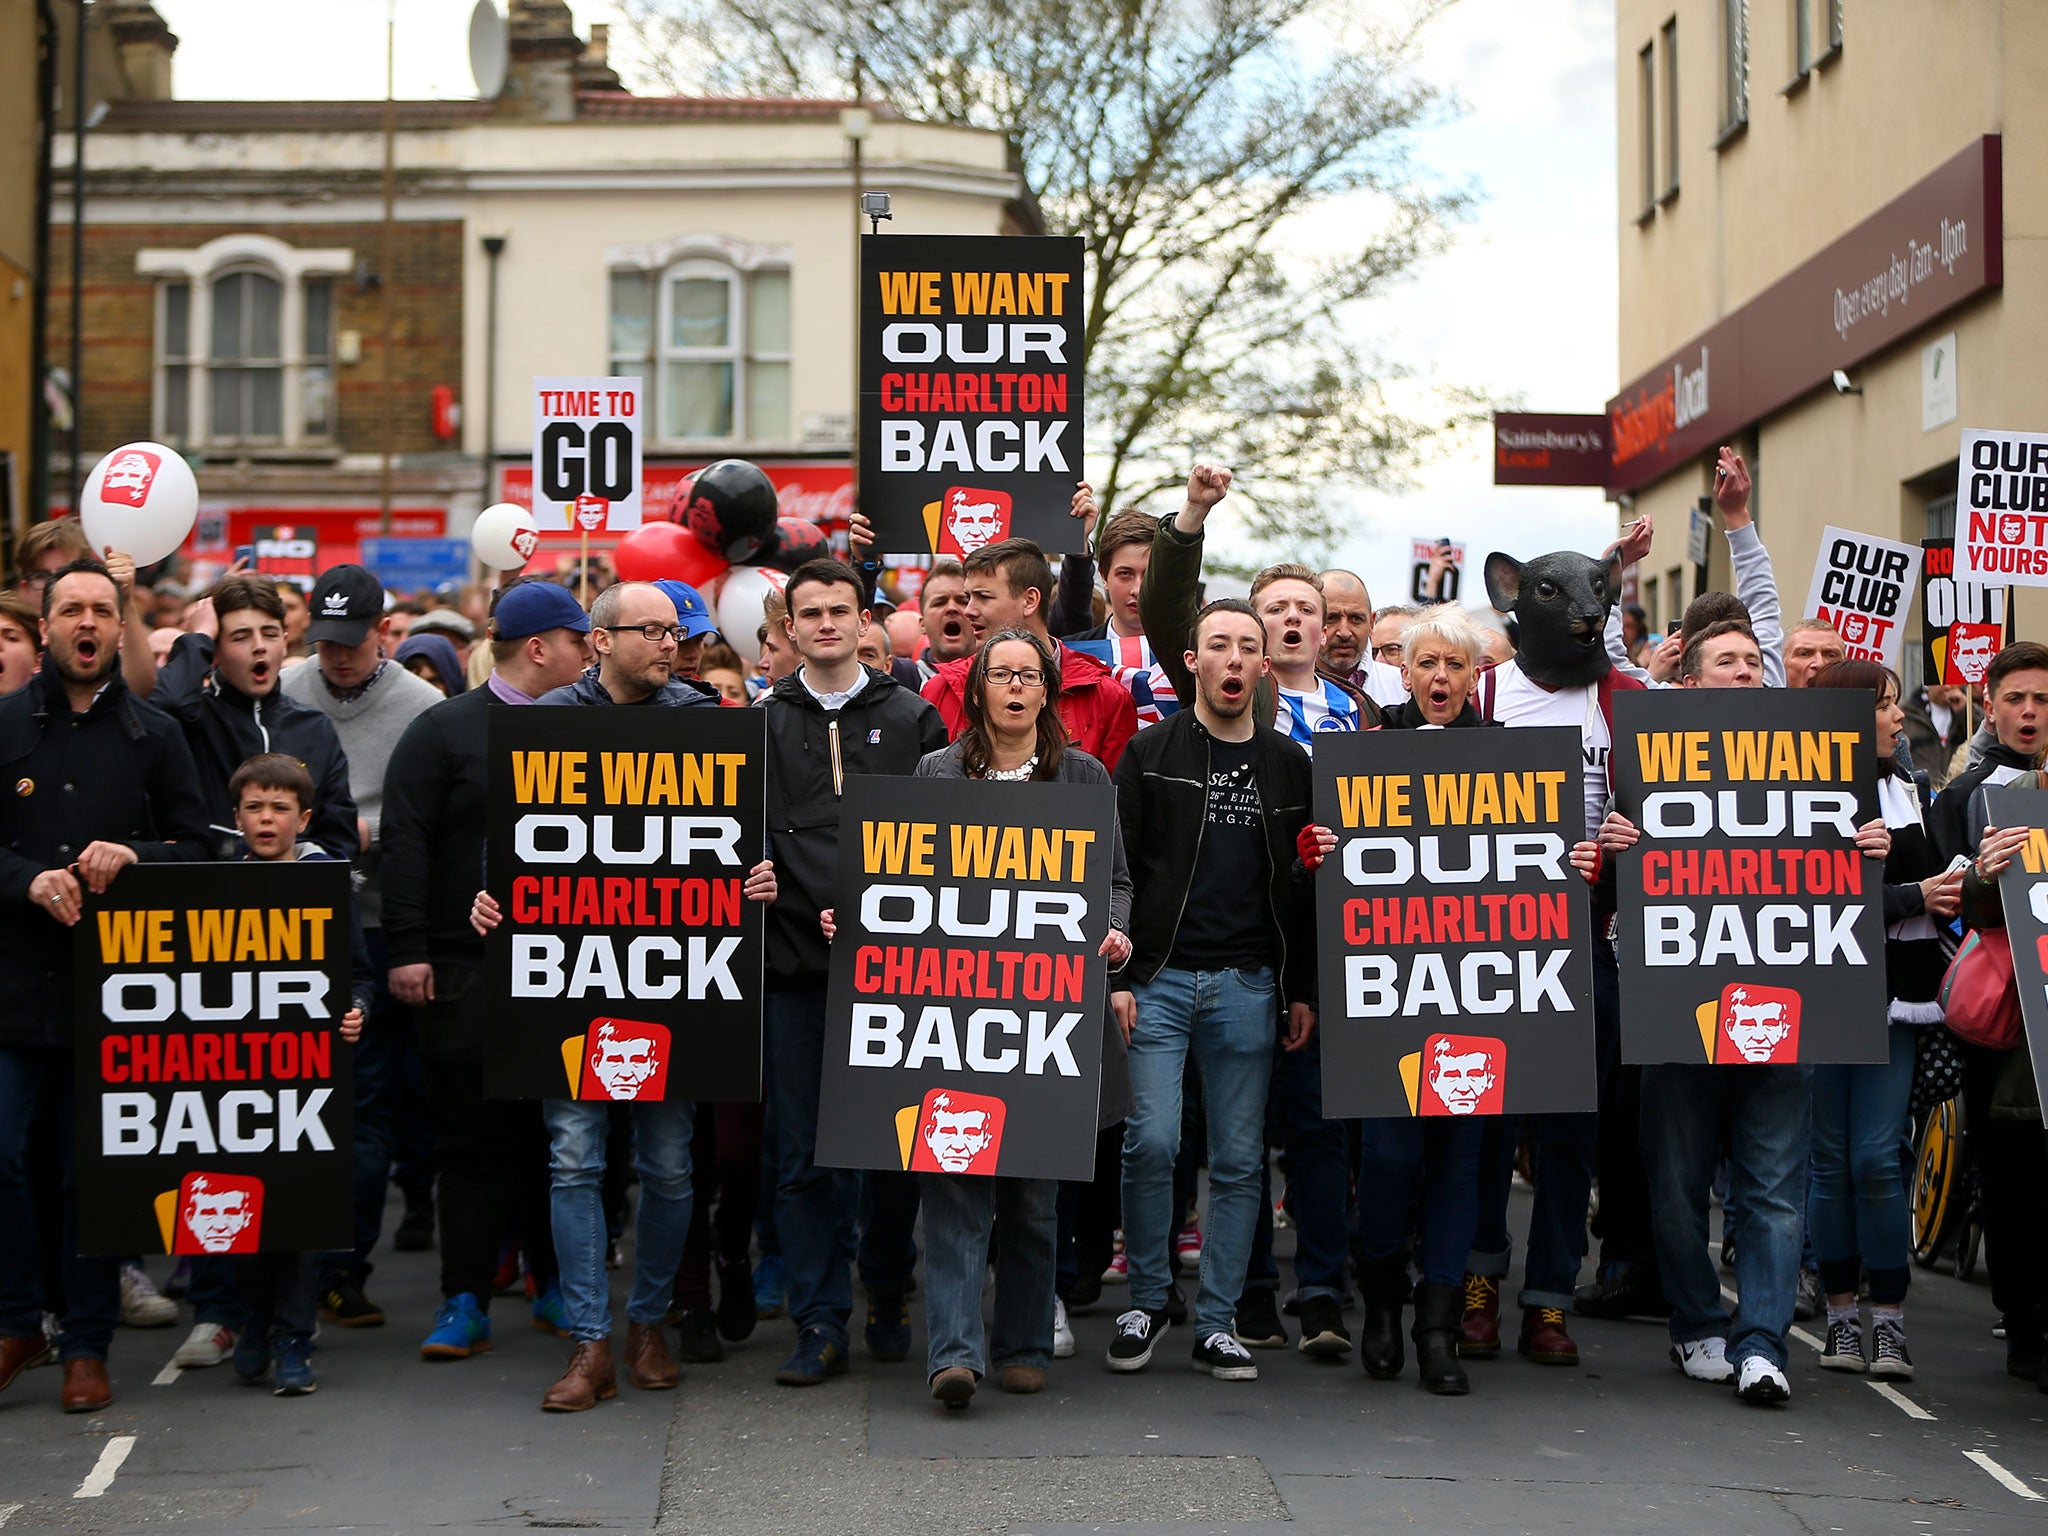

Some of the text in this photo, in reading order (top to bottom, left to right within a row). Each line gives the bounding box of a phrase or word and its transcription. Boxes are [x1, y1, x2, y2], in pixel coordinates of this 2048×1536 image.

[878, 271, 1070, 316] WE WANT
[1833, 287, 1859, 341] Open
[1861, 271, 1888, 318] every
[1887, 252, 1907, 305] day
[882, 322, 1068, 364] OUR
[539, 391, 635, 417] TIME TO
[880, 372, 1068, 413] CHARLTON
[542, 422, 633, 502] GO
[880, 419, 1071, 473] BACK
[1497, 426, 1603, 454] Sainsbury's
[1499, 448, 1550, 468] Local
[1972, 440, 2048, 475] OUR
[1969, 473, 2048, 512] CLUB
[1829, 538, 1909, 584] OUR
[1967, 545, 2048, 575] YOURS
[1820, 569, 1902, 618] CLUB
[511, 750, 747, 807] WE WANT
[1635, 730, 1861, 783] WE WANT
[1234, 805, 1261, 815] EXPERIE
[1335, 770, 1566, 829] WE WANT
[1641, 790, 1861, 840] OUR
[514, 814, 743, 866] OUR
[861, 820, 1096, 883] WE WANT
[1342, 832, 1568, 886] OUR
[1641, 848, 1863, 897] CHARLTON
[512, 875, 741, 927] CHARLTON
[859, 883, 1088, 943] OUR
[1342, 892, 1570, 946] CHARLTON
[97, 907, 333, 964] WE WANT
[1643, 904, 1869, 967] BACK
[511, 933, 744, 1001] BACK
[853, 944, 1085, 1003] CHARLTON
[1344, 948, 1576, 1018] BACK
[101, 970, 332, 1023] OUR
[101, 1031, 331, 1083] CHARLTON
[848, 1002, 1085, 1077] BACK
[101, 1087, 335, 1156] BACK
